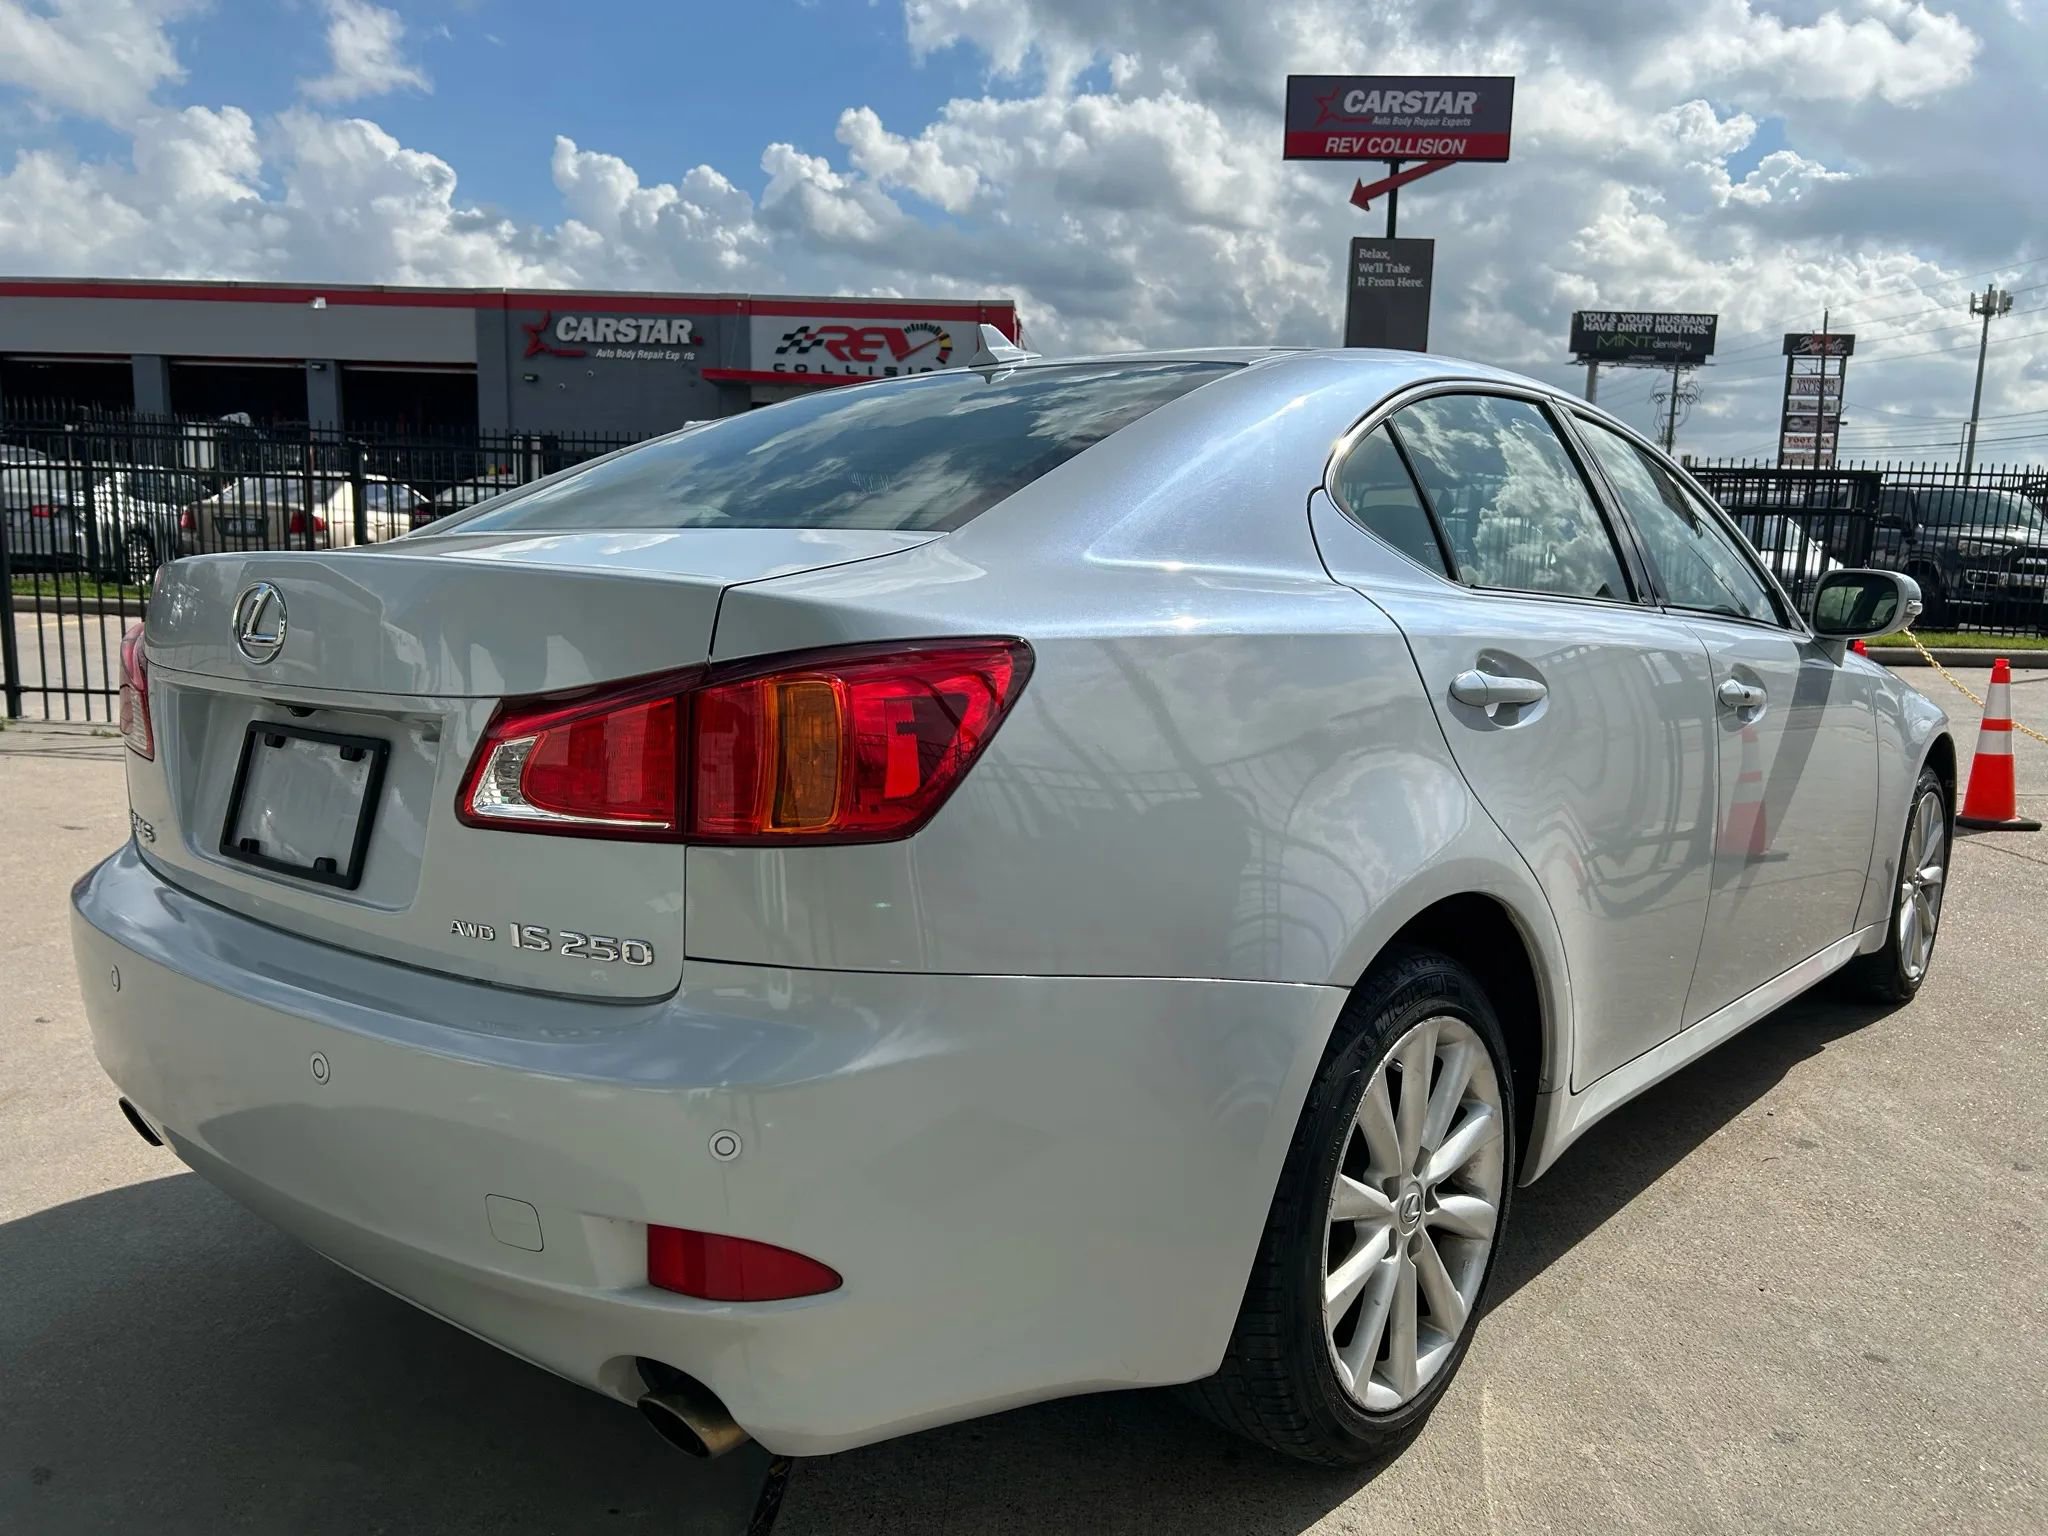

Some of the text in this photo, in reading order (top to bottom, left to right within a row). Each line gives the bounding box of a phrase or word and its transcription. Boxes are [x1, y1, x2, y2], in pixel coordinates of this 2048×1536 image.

[1343, 90, 1478, 115] CARSTAR
[1371, 115, 1471, 128] Auto Body Repair Experts
[1325, 137, 1467, 155] REV COLLISION
[1358, 248, 1391, 261] Relax,
[1358, 262, 1411, 274] We'll Take
[1357, 276, 1366, 288] It
[1367, 277, 1396, 288] From
[1581, 312, 1714, 326] YOU & YOUR HUSBAND
[555, 316, 694, 345] CARSTAR
[1583, 322, 1709, 336] HAVE DIRTY MOUTHS.
[806, 325, 917, 363] REV
[596, 349, 615, 359] Auto
[615, 350, 636, 361] Body
[637, 350, 665, 361] Repair
[450, 919, 496, 942] AWD
[509, 921, 655, 967] IS 250
